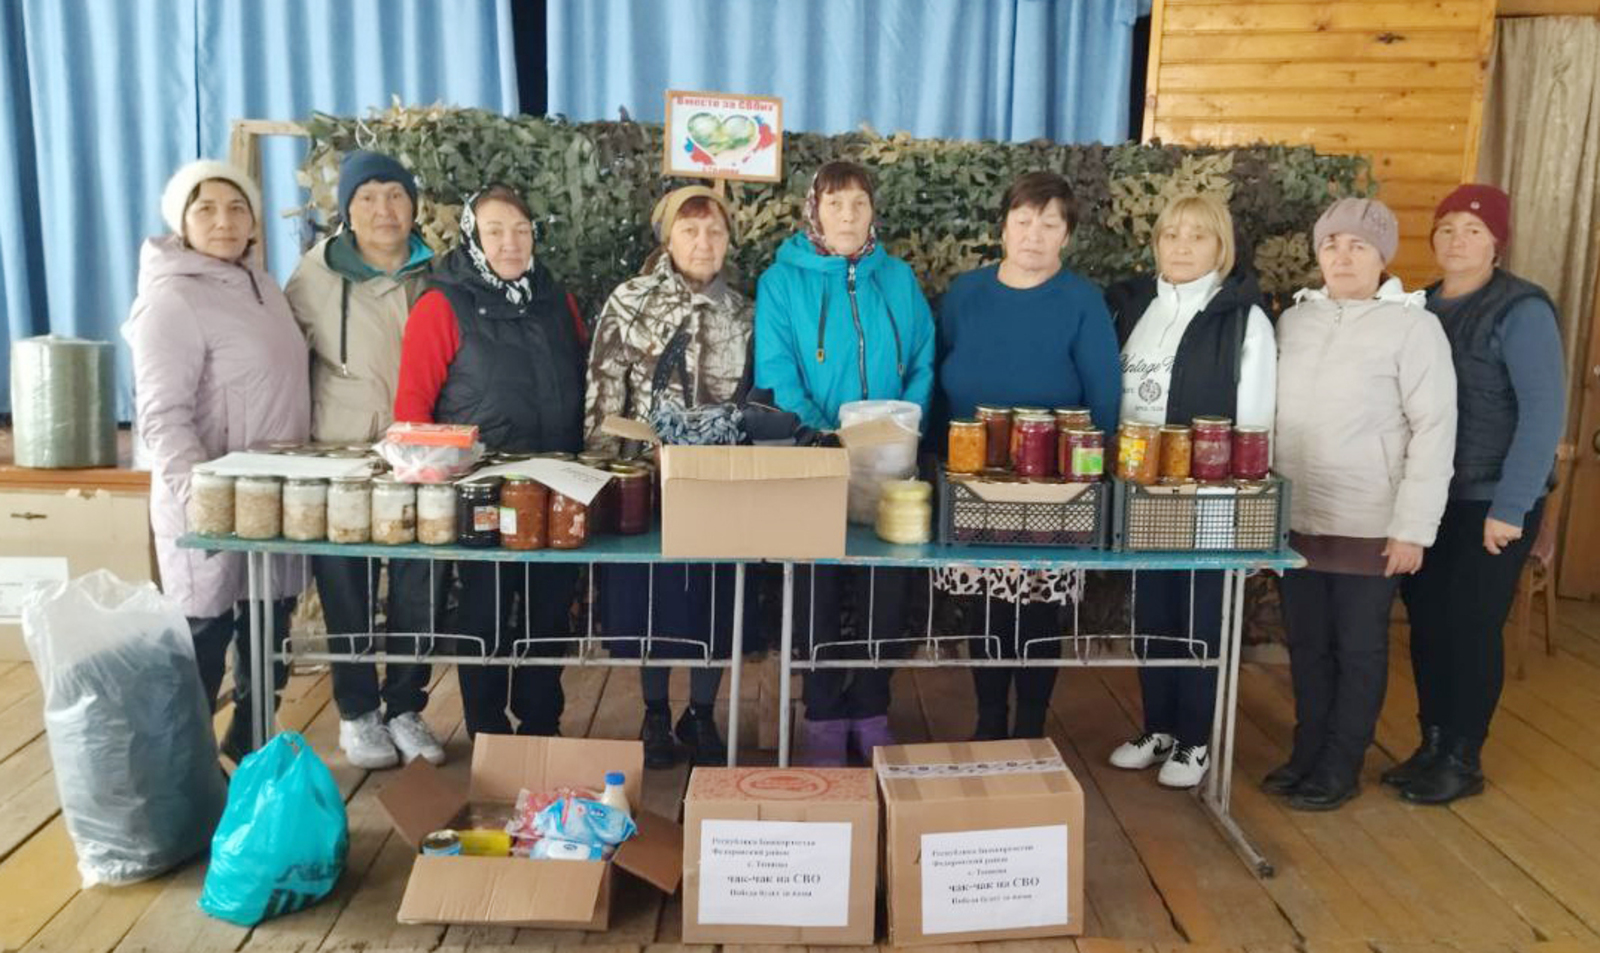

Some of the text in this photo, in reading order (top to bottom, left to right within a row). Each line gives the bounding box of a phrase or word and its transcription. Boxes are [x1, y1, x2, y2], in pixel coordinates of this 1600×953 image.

[727, 873, 821, 884] чак-чак на СВО
[948, 876, 1040, 892] чак-чак на СВО
